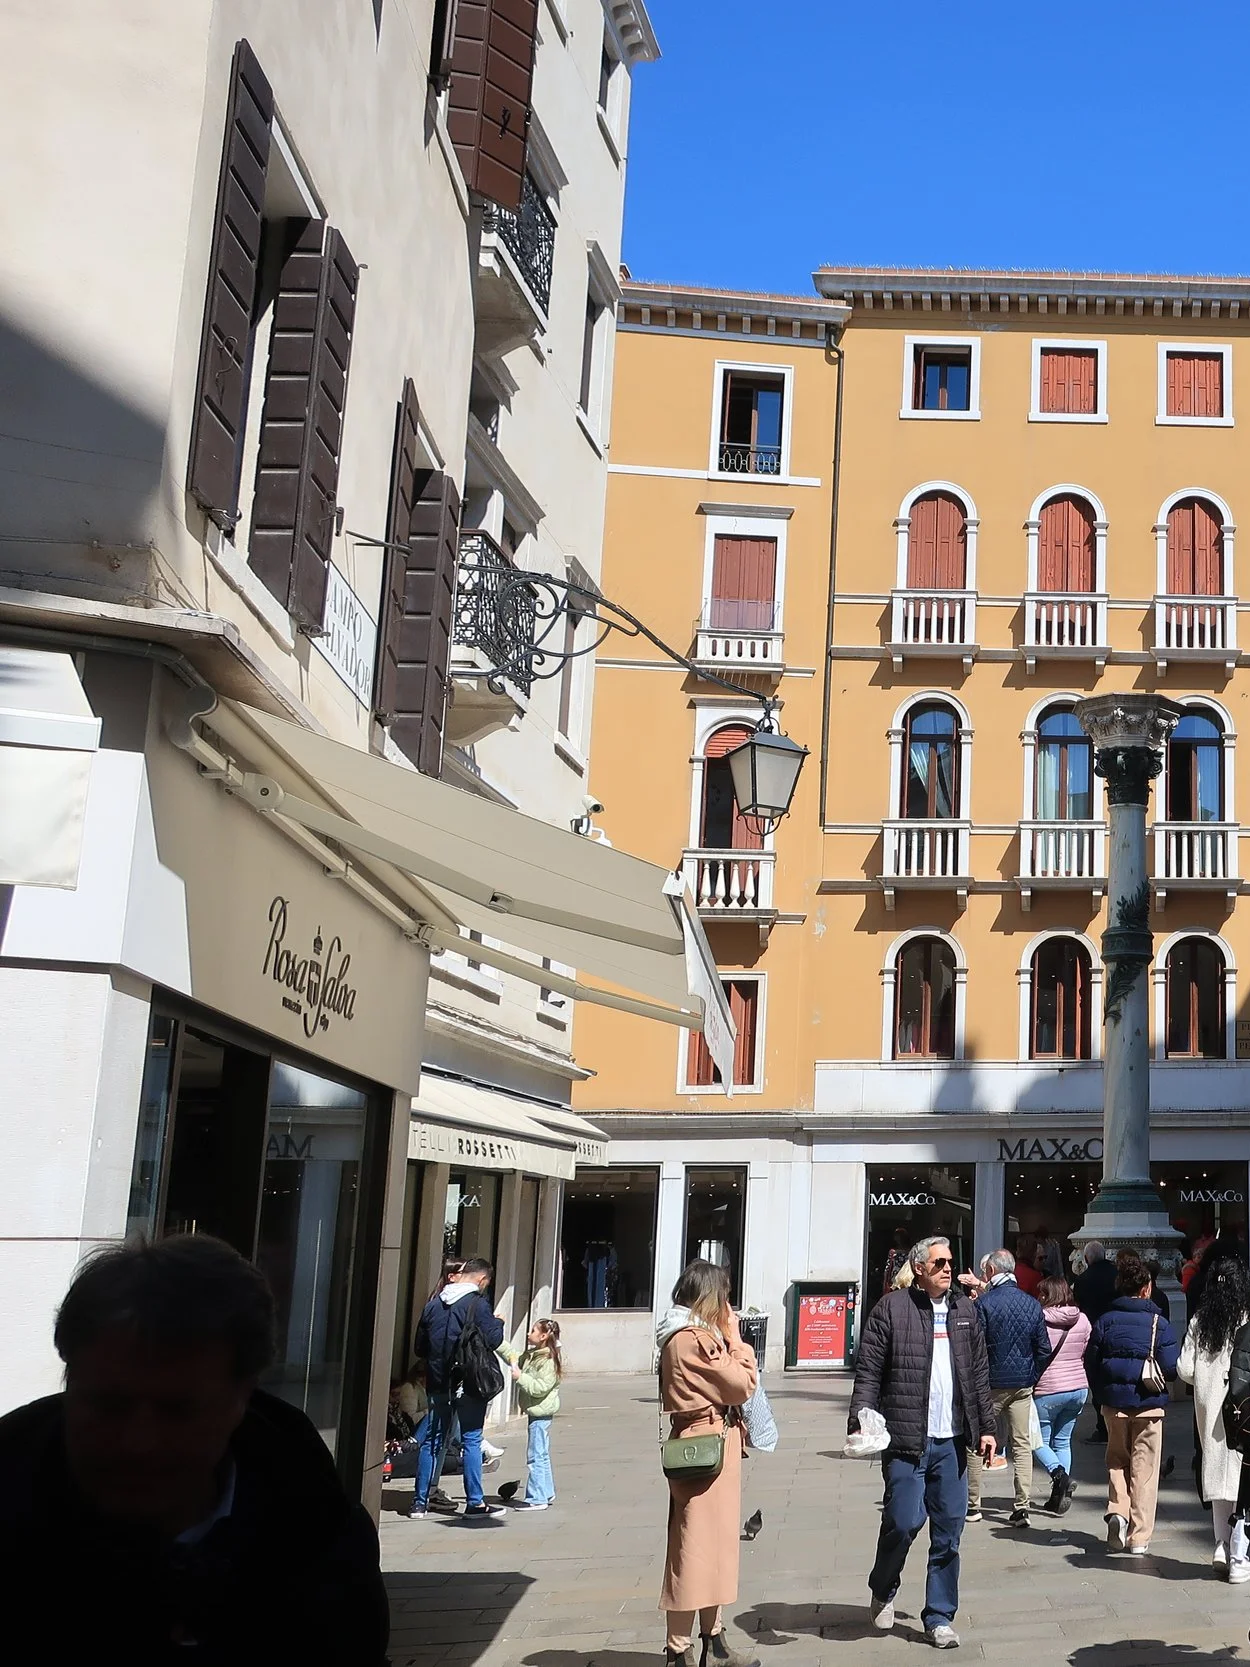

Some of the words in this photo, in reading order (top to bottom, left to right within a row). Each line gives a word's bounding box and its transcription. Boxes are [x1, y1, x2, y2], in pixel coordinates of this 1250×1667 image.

[322, 615, 371, 697] ALVADOR
[262, 896, 307, 994] Rosa
[303, 936, 357, 1038] Salva
[412, 1130, 452, 1153] TELLI
[457, 1137, 518, 1161] ROSSETTI
[997, 1137, 1103, 1161] MAX&C
